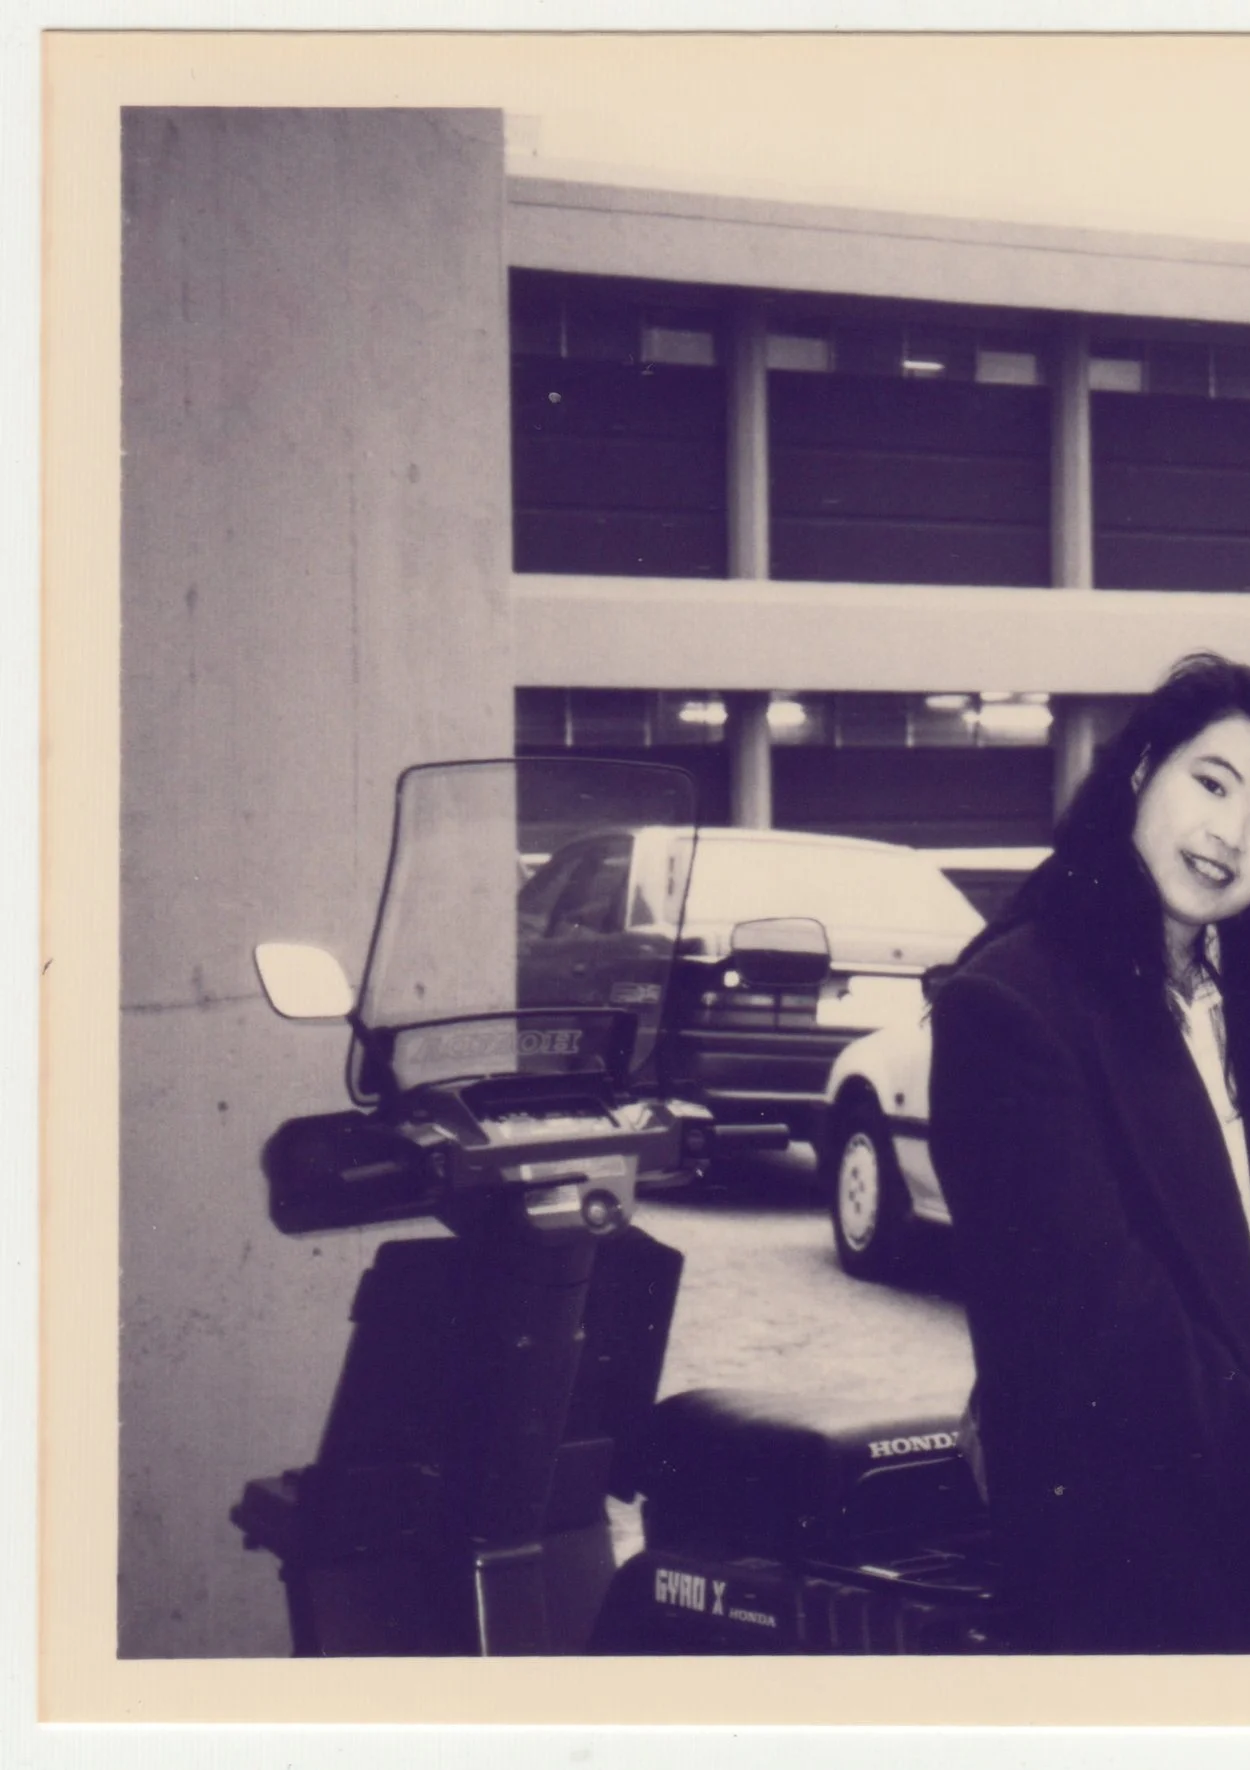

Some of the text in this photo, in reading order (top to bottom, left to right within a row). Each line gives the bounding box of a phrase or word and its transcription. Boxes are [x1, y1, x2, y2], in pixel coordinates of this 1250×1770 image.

[655, 1568, 726, 1616] GYRO X
[729, 1607, 777, 1628] HONDA
